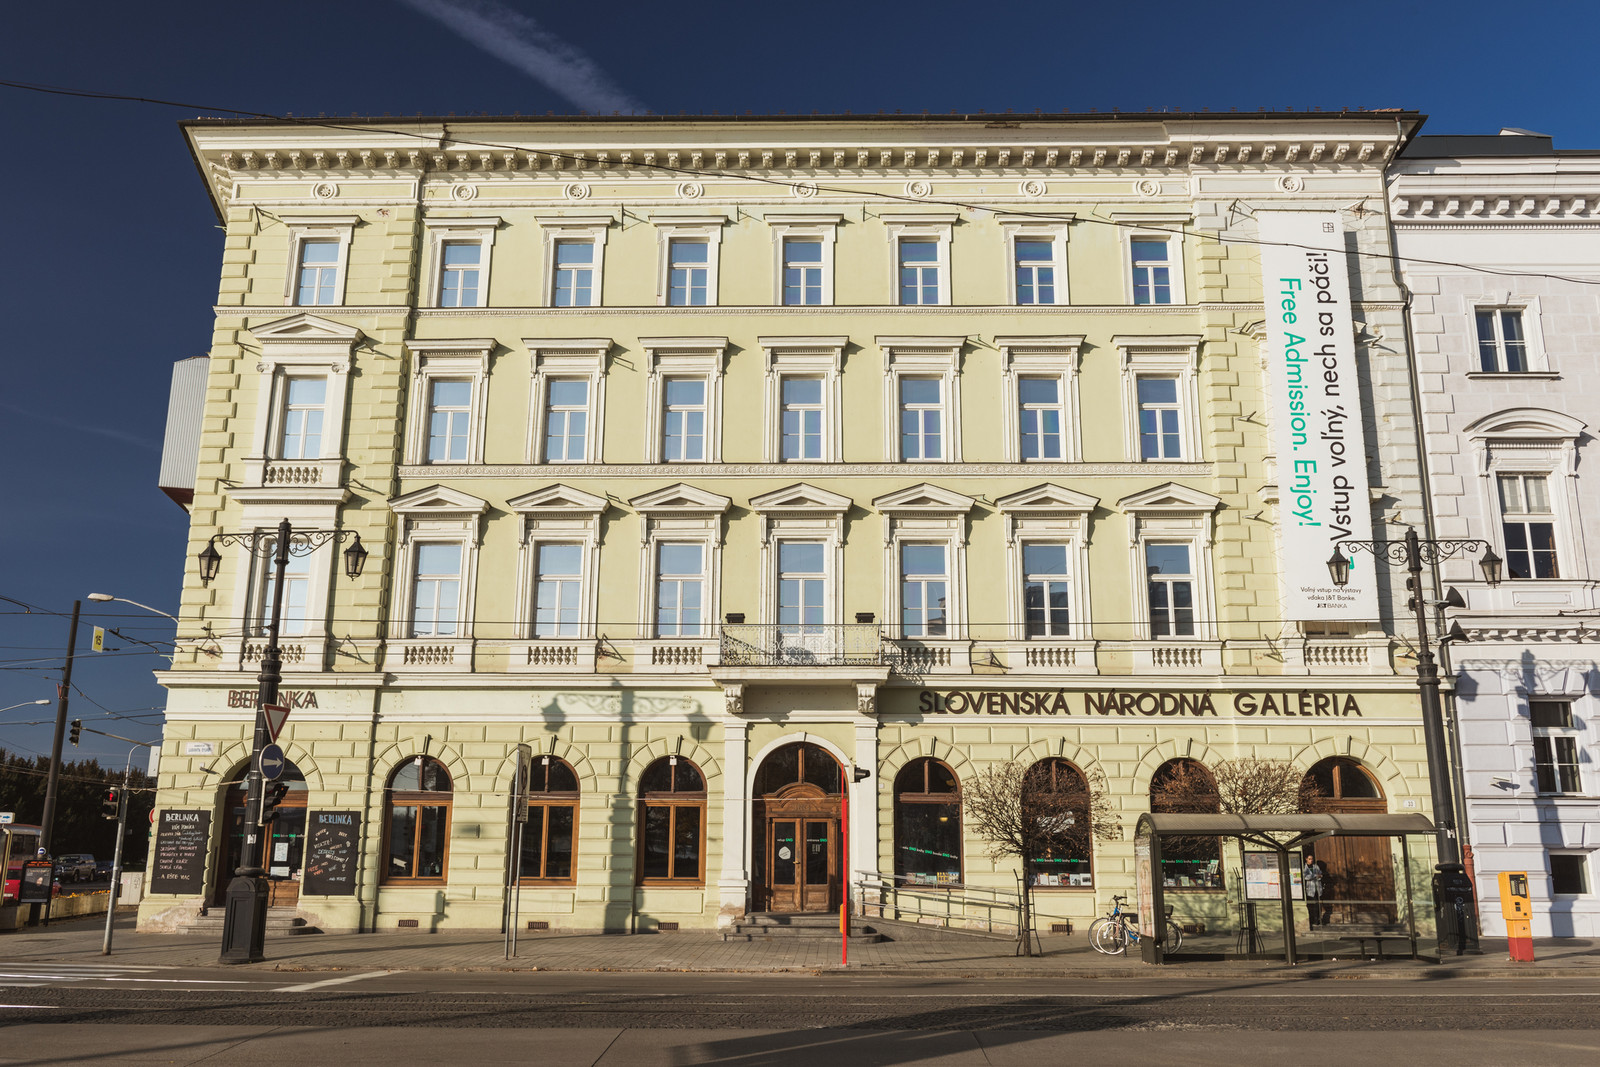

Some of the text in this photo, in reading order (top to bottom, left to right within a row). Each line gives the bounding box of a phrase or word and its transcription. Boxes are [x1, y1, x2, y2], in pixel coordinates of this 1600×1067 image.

[1279, 278, 1322, 527] Free Admission. Enjoy!
[1306, 252, 1354, 541] Vstup voľný, nech sa páči!
[95, 634, 102, 646] 15
[918, 687, 1362, 717] SLOVENSKÁ NÁRODNÁ GALÉRIA
[165, 813, 199, 822] BERLINKA
[318, 814, 352, 825] BERLINKA
